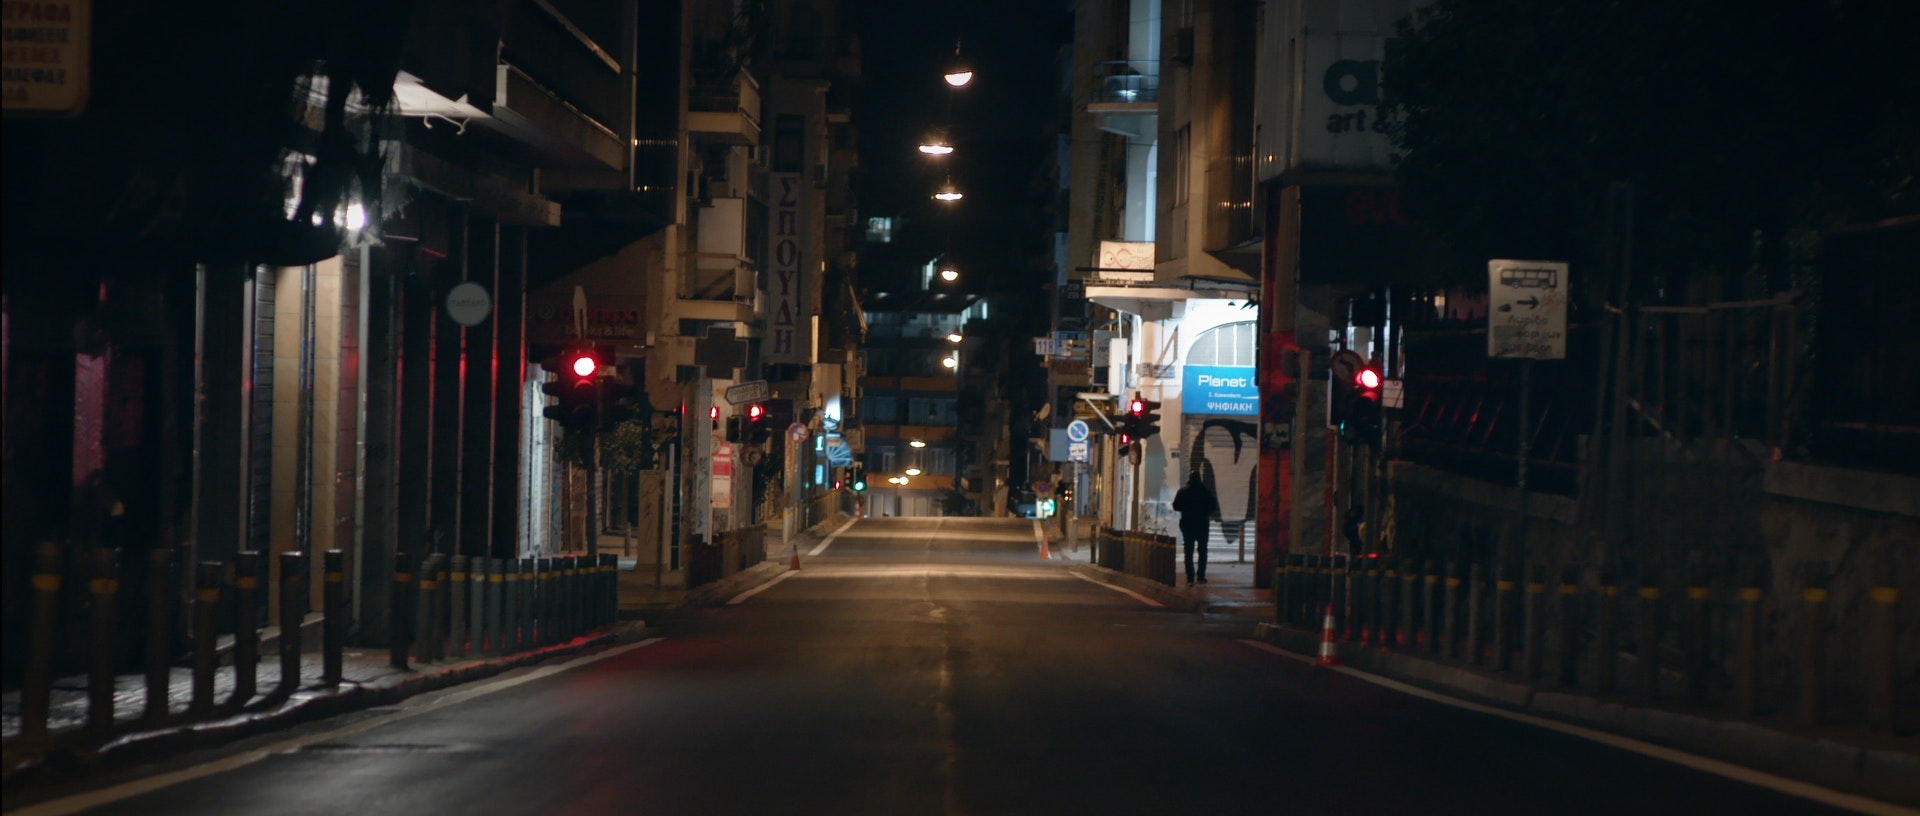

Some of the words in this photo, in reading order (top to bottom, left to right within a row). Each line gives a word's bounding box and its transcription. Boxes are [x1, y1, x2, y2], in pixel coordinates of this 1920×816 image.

[1327, 109, 1366, 133] art
[775, 176, 798, 355] ΣΠΟΥΔΗ
[1037, 340, 1054, 353] 118
[1198, 374, 1247, 388] Planet
[1207, 402, 1253, 412] ΨΗΦΙΑΚΗ
